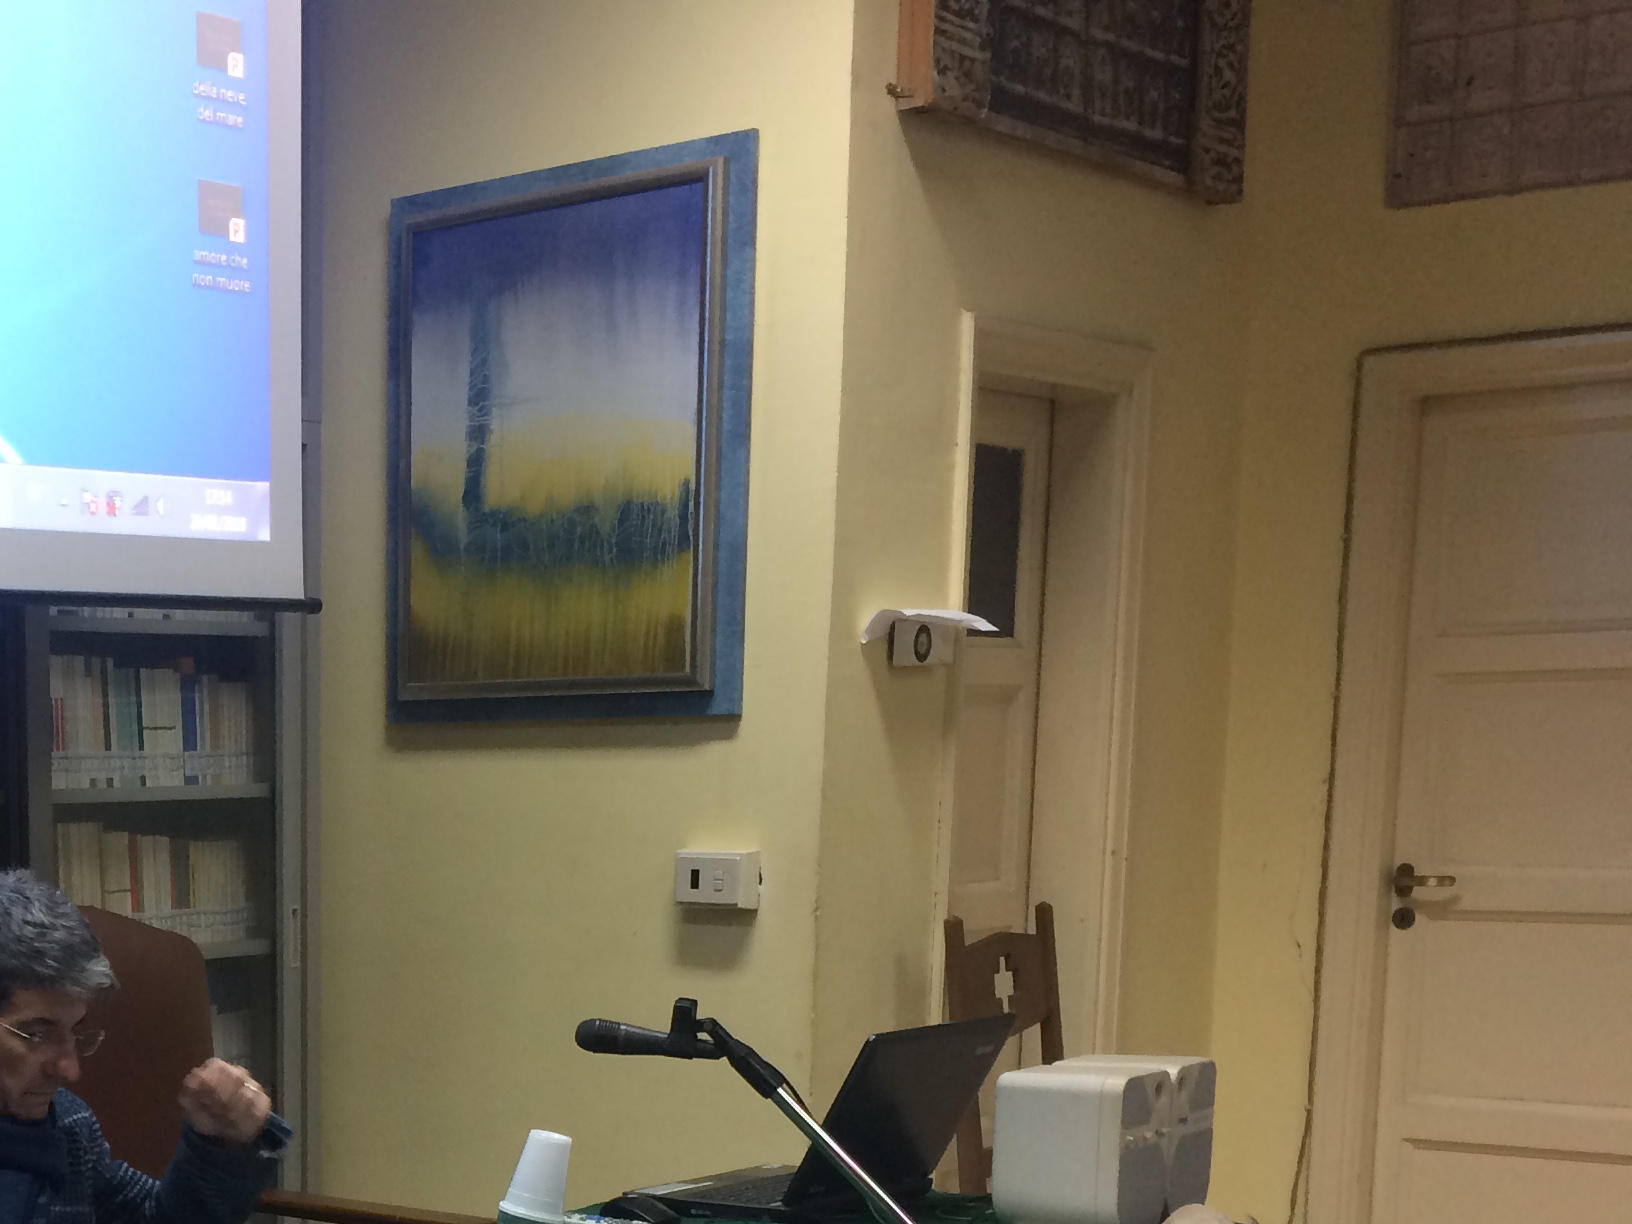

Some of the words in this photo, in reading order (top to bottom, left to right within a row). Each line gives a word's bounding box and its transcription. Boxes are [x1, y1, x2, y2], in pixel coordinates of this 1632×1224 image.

[192, 249, 228, 267] amore
[229, 252, 248, 270] che
[192, 272, 214, 288] non
[216, 276, 251, 293] muore
